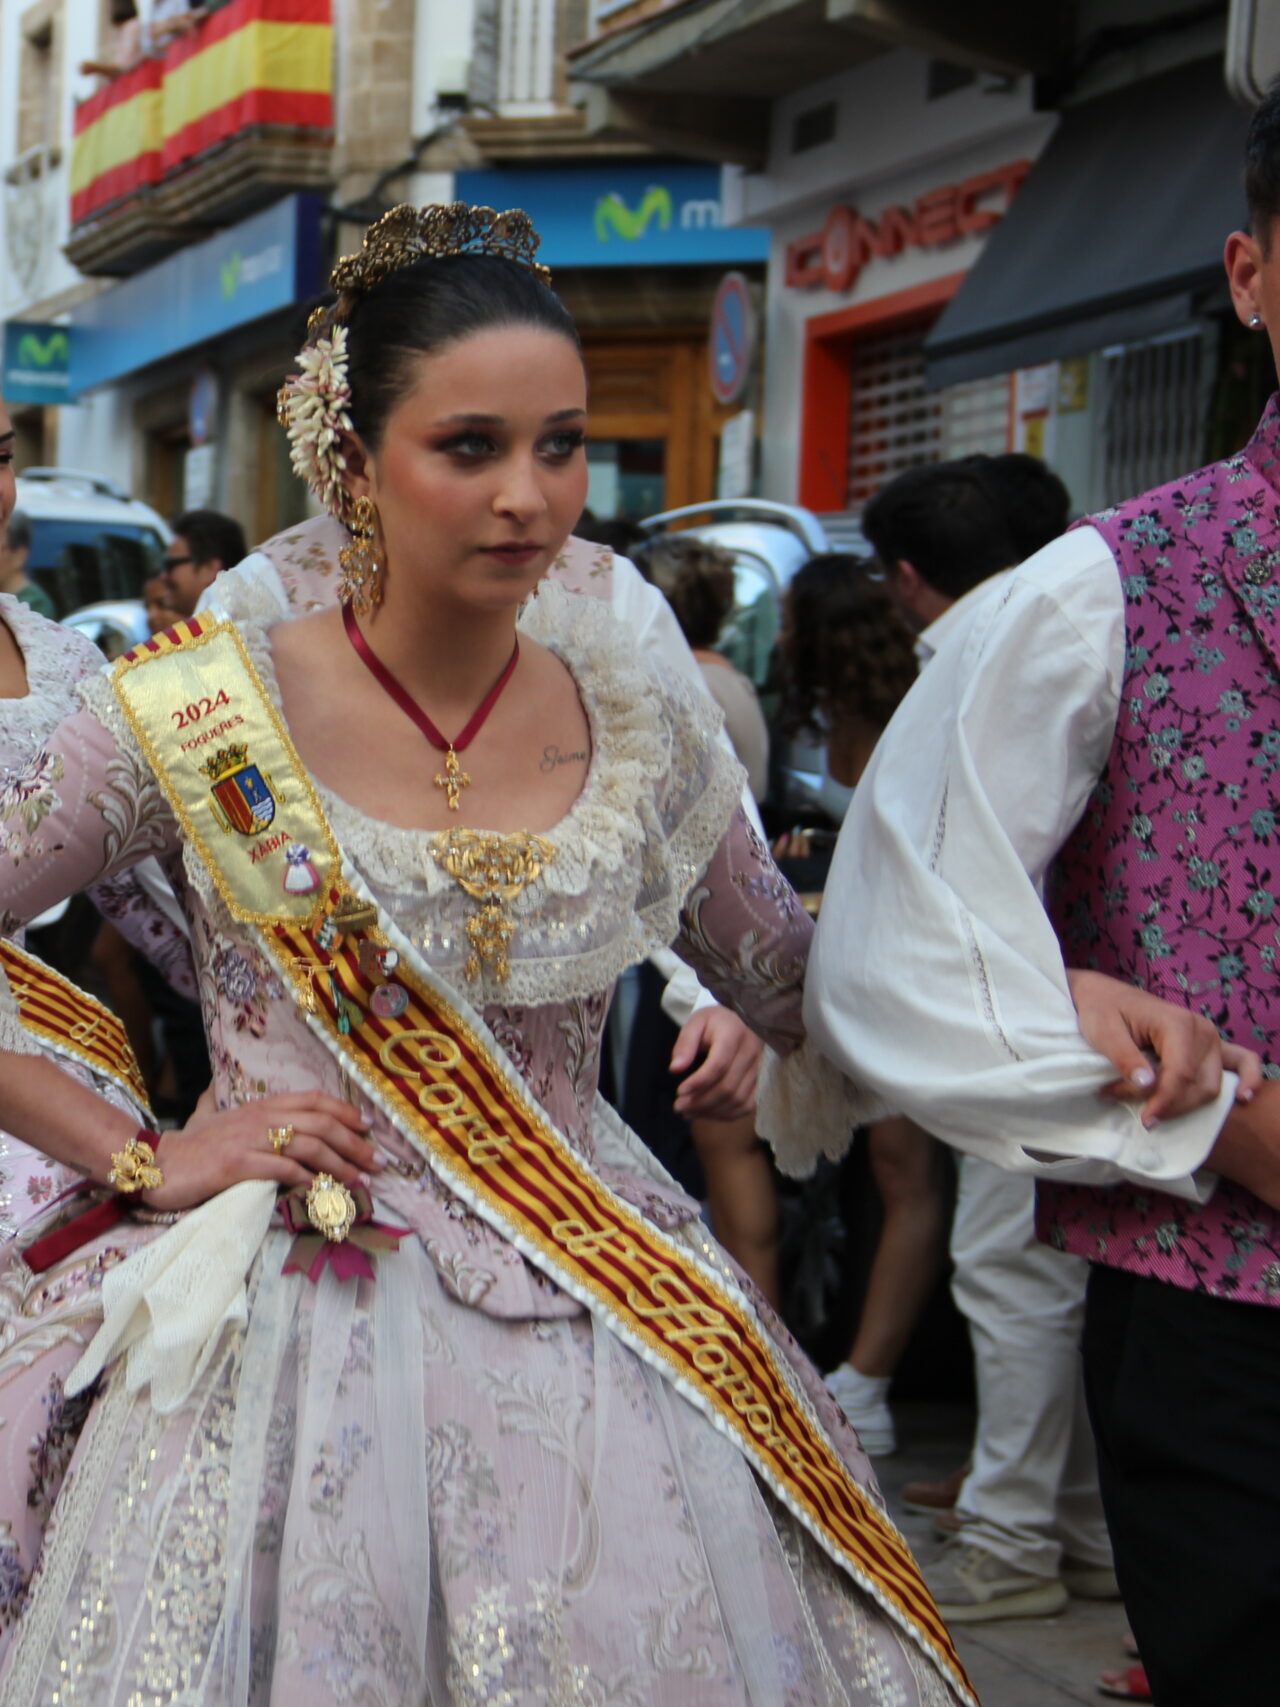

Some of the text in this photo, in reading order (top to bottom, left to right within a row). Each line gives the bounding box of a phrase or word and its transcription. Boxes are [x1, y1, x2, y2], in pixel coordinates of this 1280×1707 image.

[171, 688, 230, 729] 2024
[180, 714, 245, 752] FOGUERES
[379, 1029, 512, 1165] Cort
